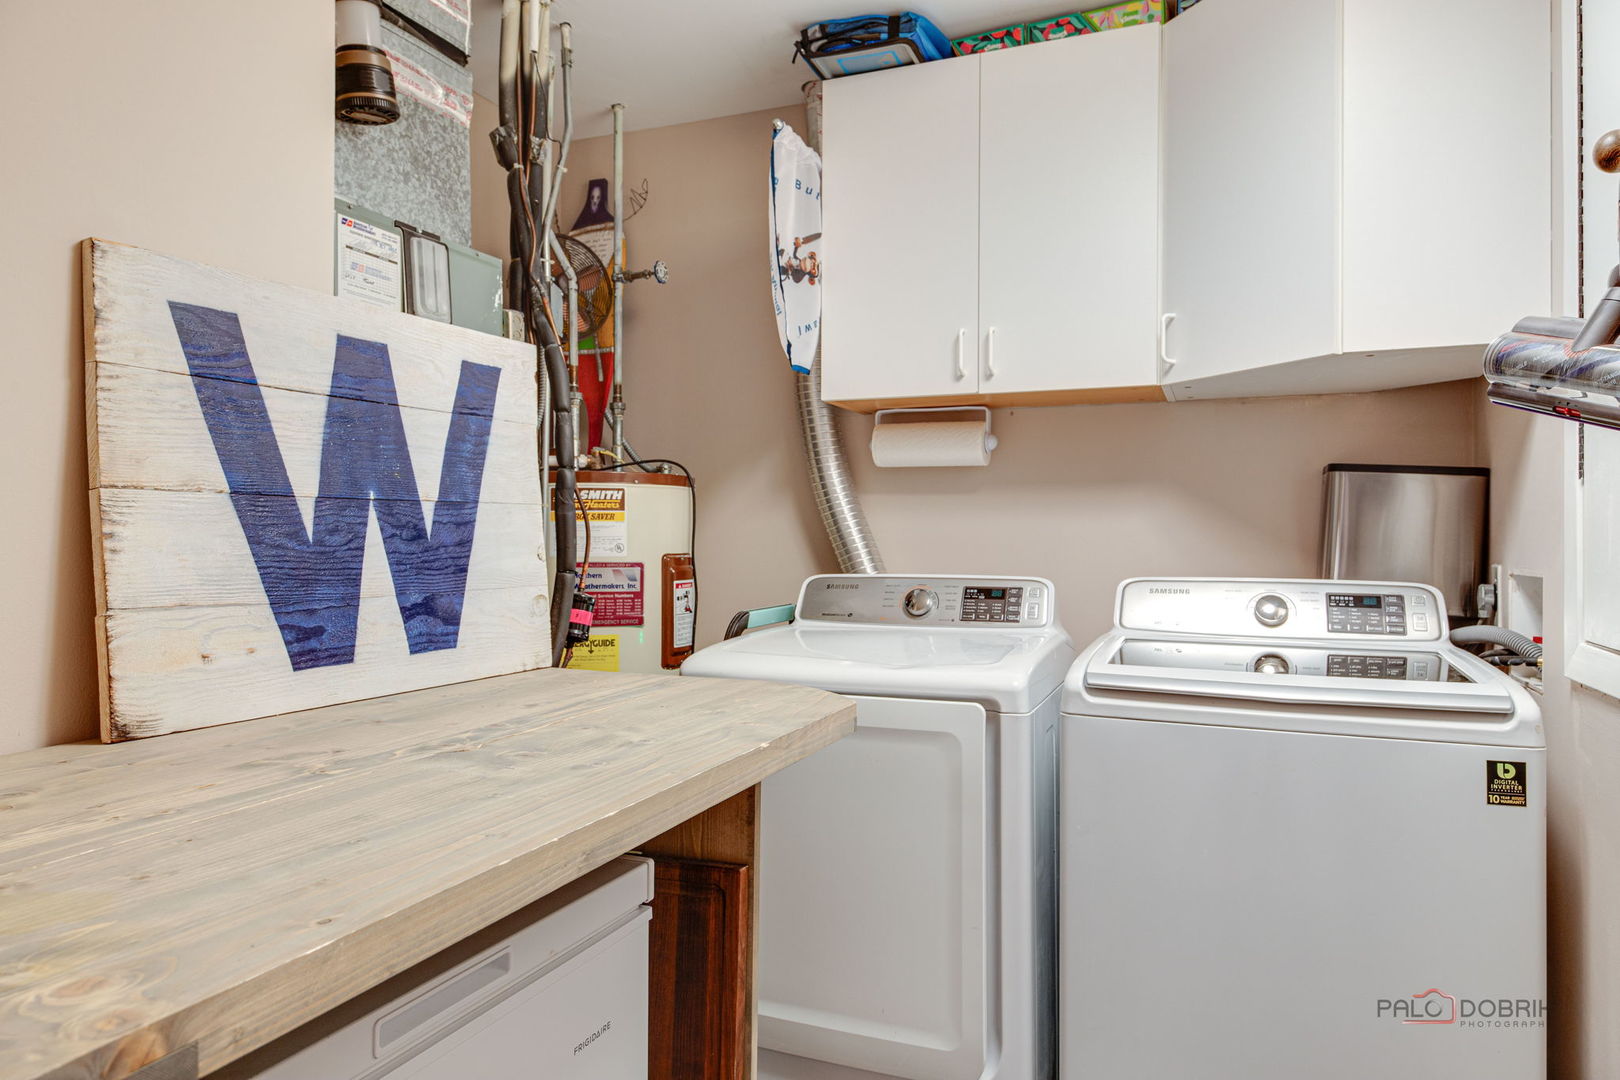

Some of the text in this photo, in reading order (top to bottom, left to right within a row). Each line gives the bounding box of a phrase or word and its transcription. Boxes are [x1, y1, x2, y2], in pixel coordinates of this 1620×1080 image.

[167, 300, 501, 671] W
[580, 490, 623, 500] SMITH
[1488, 794, 1500, 804] 10
[574, 1020, 611, 1056] FRIGIDAIRE
